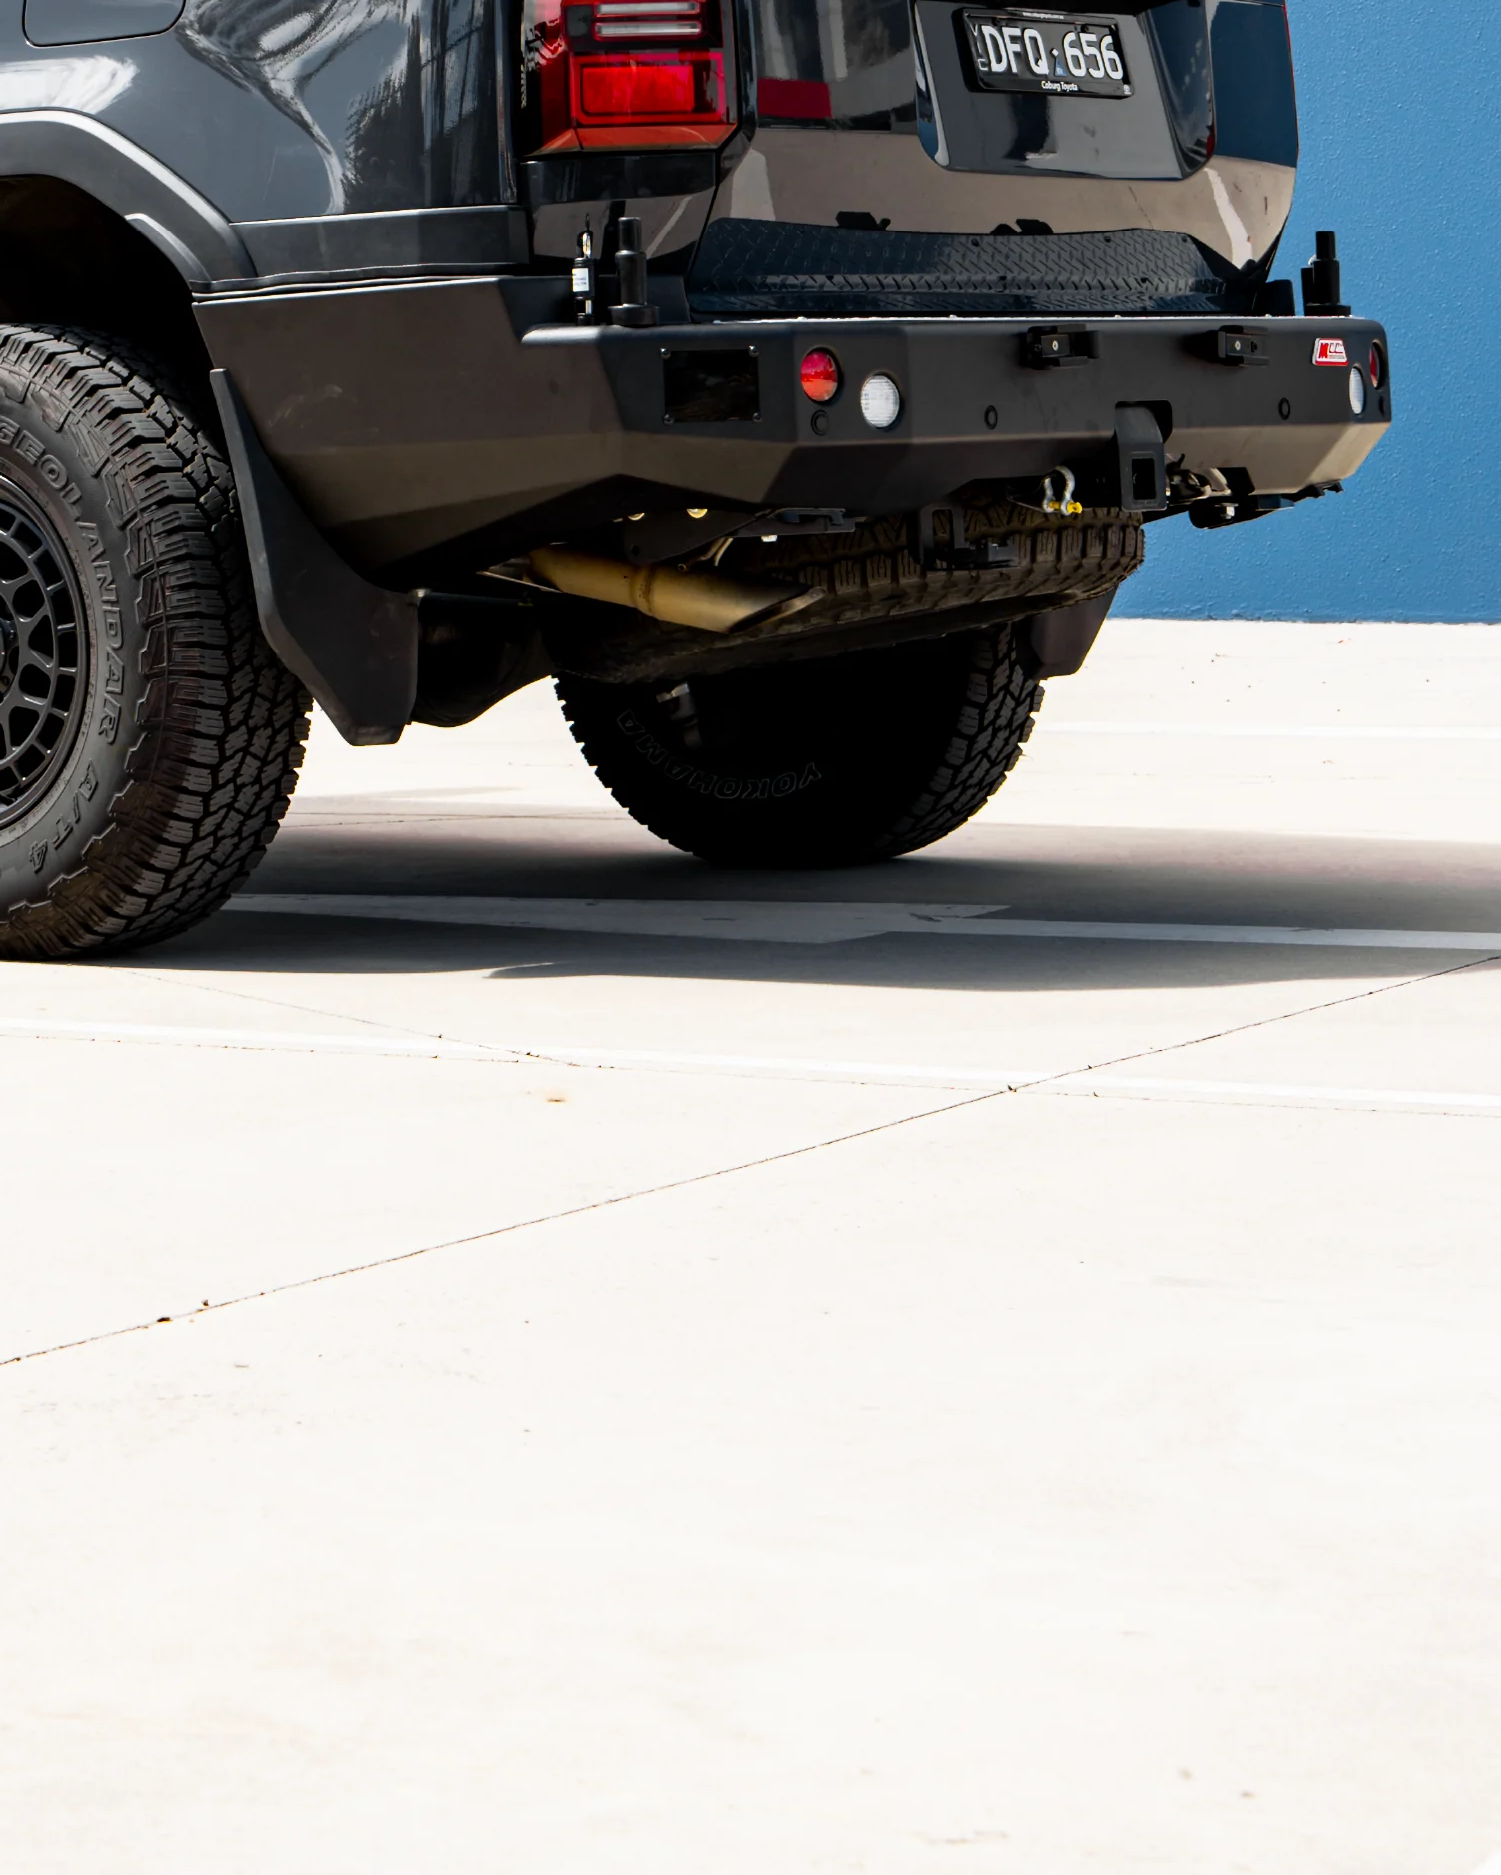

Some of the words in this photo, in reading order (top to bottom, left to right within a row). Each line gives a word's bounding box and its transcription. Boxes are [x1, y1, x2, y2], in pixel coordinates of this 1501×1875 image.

[981, 24, 1050, 75] DFQ
[1063, 31, 1124, 80] 656
[1041, 80, 1060, 92] Coburg
[1059, 81, 1079, 92] Toyota
[616, 708, 823, 800] YOKOHAMA
